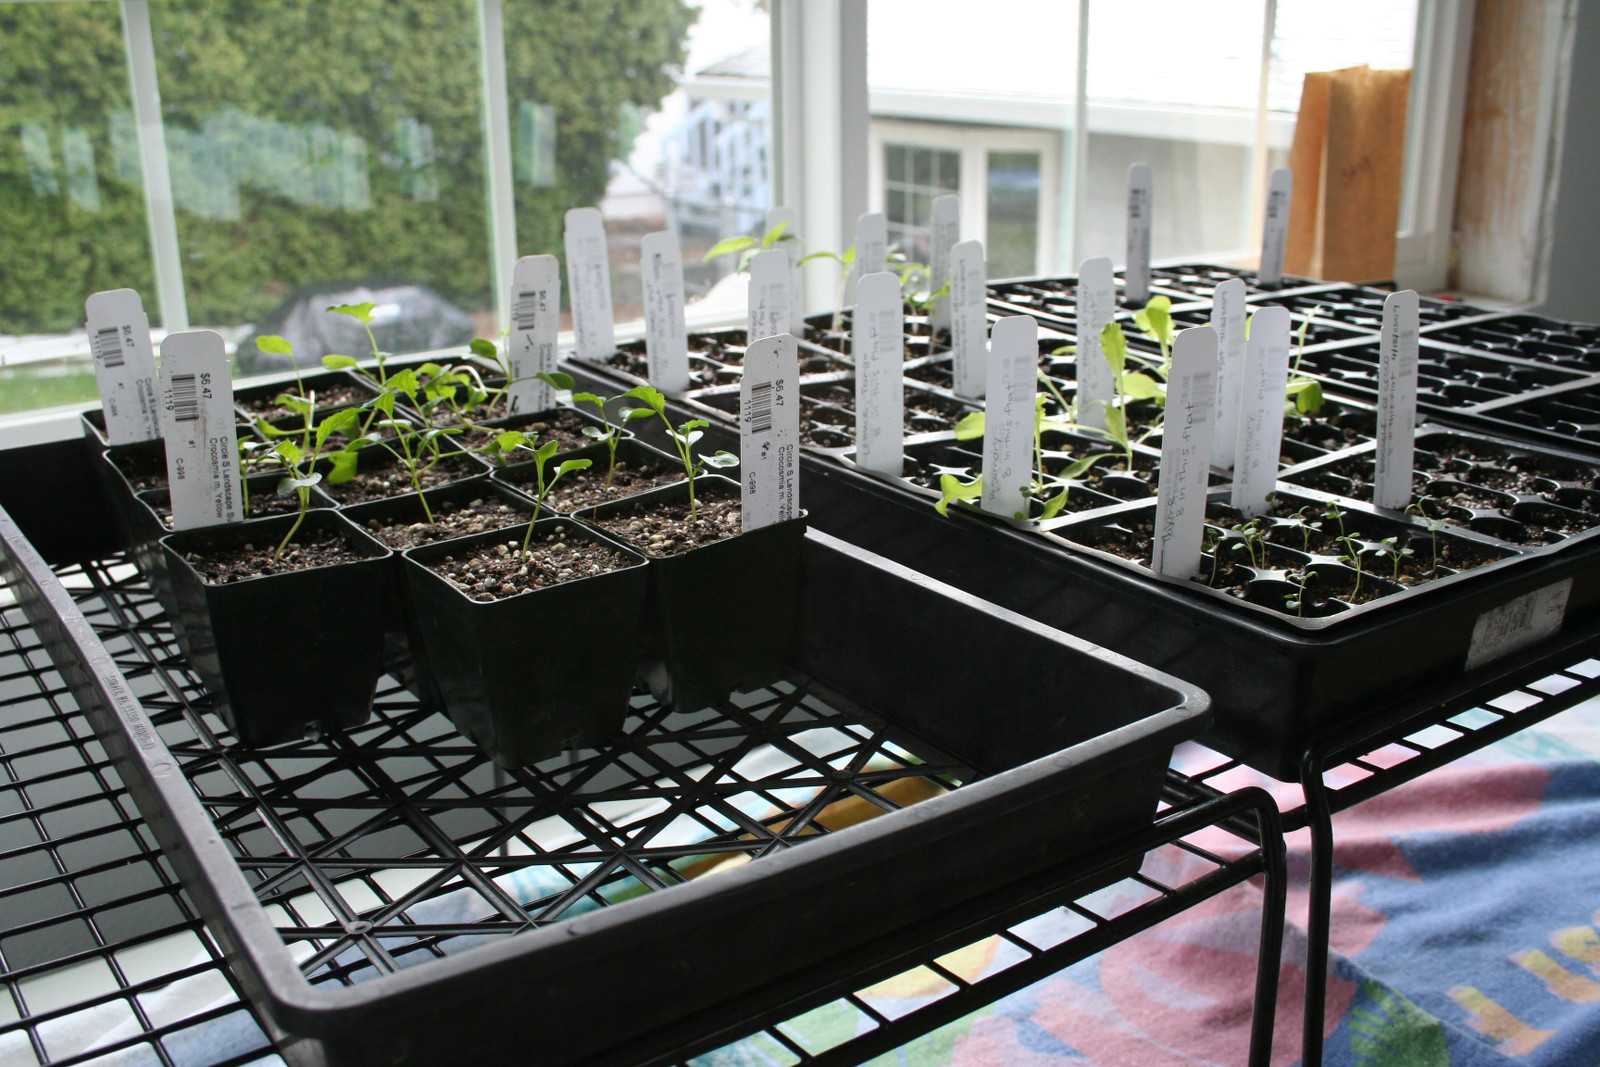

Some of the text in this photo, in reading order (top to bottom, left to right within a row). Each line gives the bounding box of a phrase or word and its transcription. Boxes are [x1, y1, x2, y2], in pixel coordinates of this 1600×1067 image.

[743, 400, 751, 423] 1119
[210, 438, 221, 479] Crocosmia
[219, 436, 229, 459] Circle
